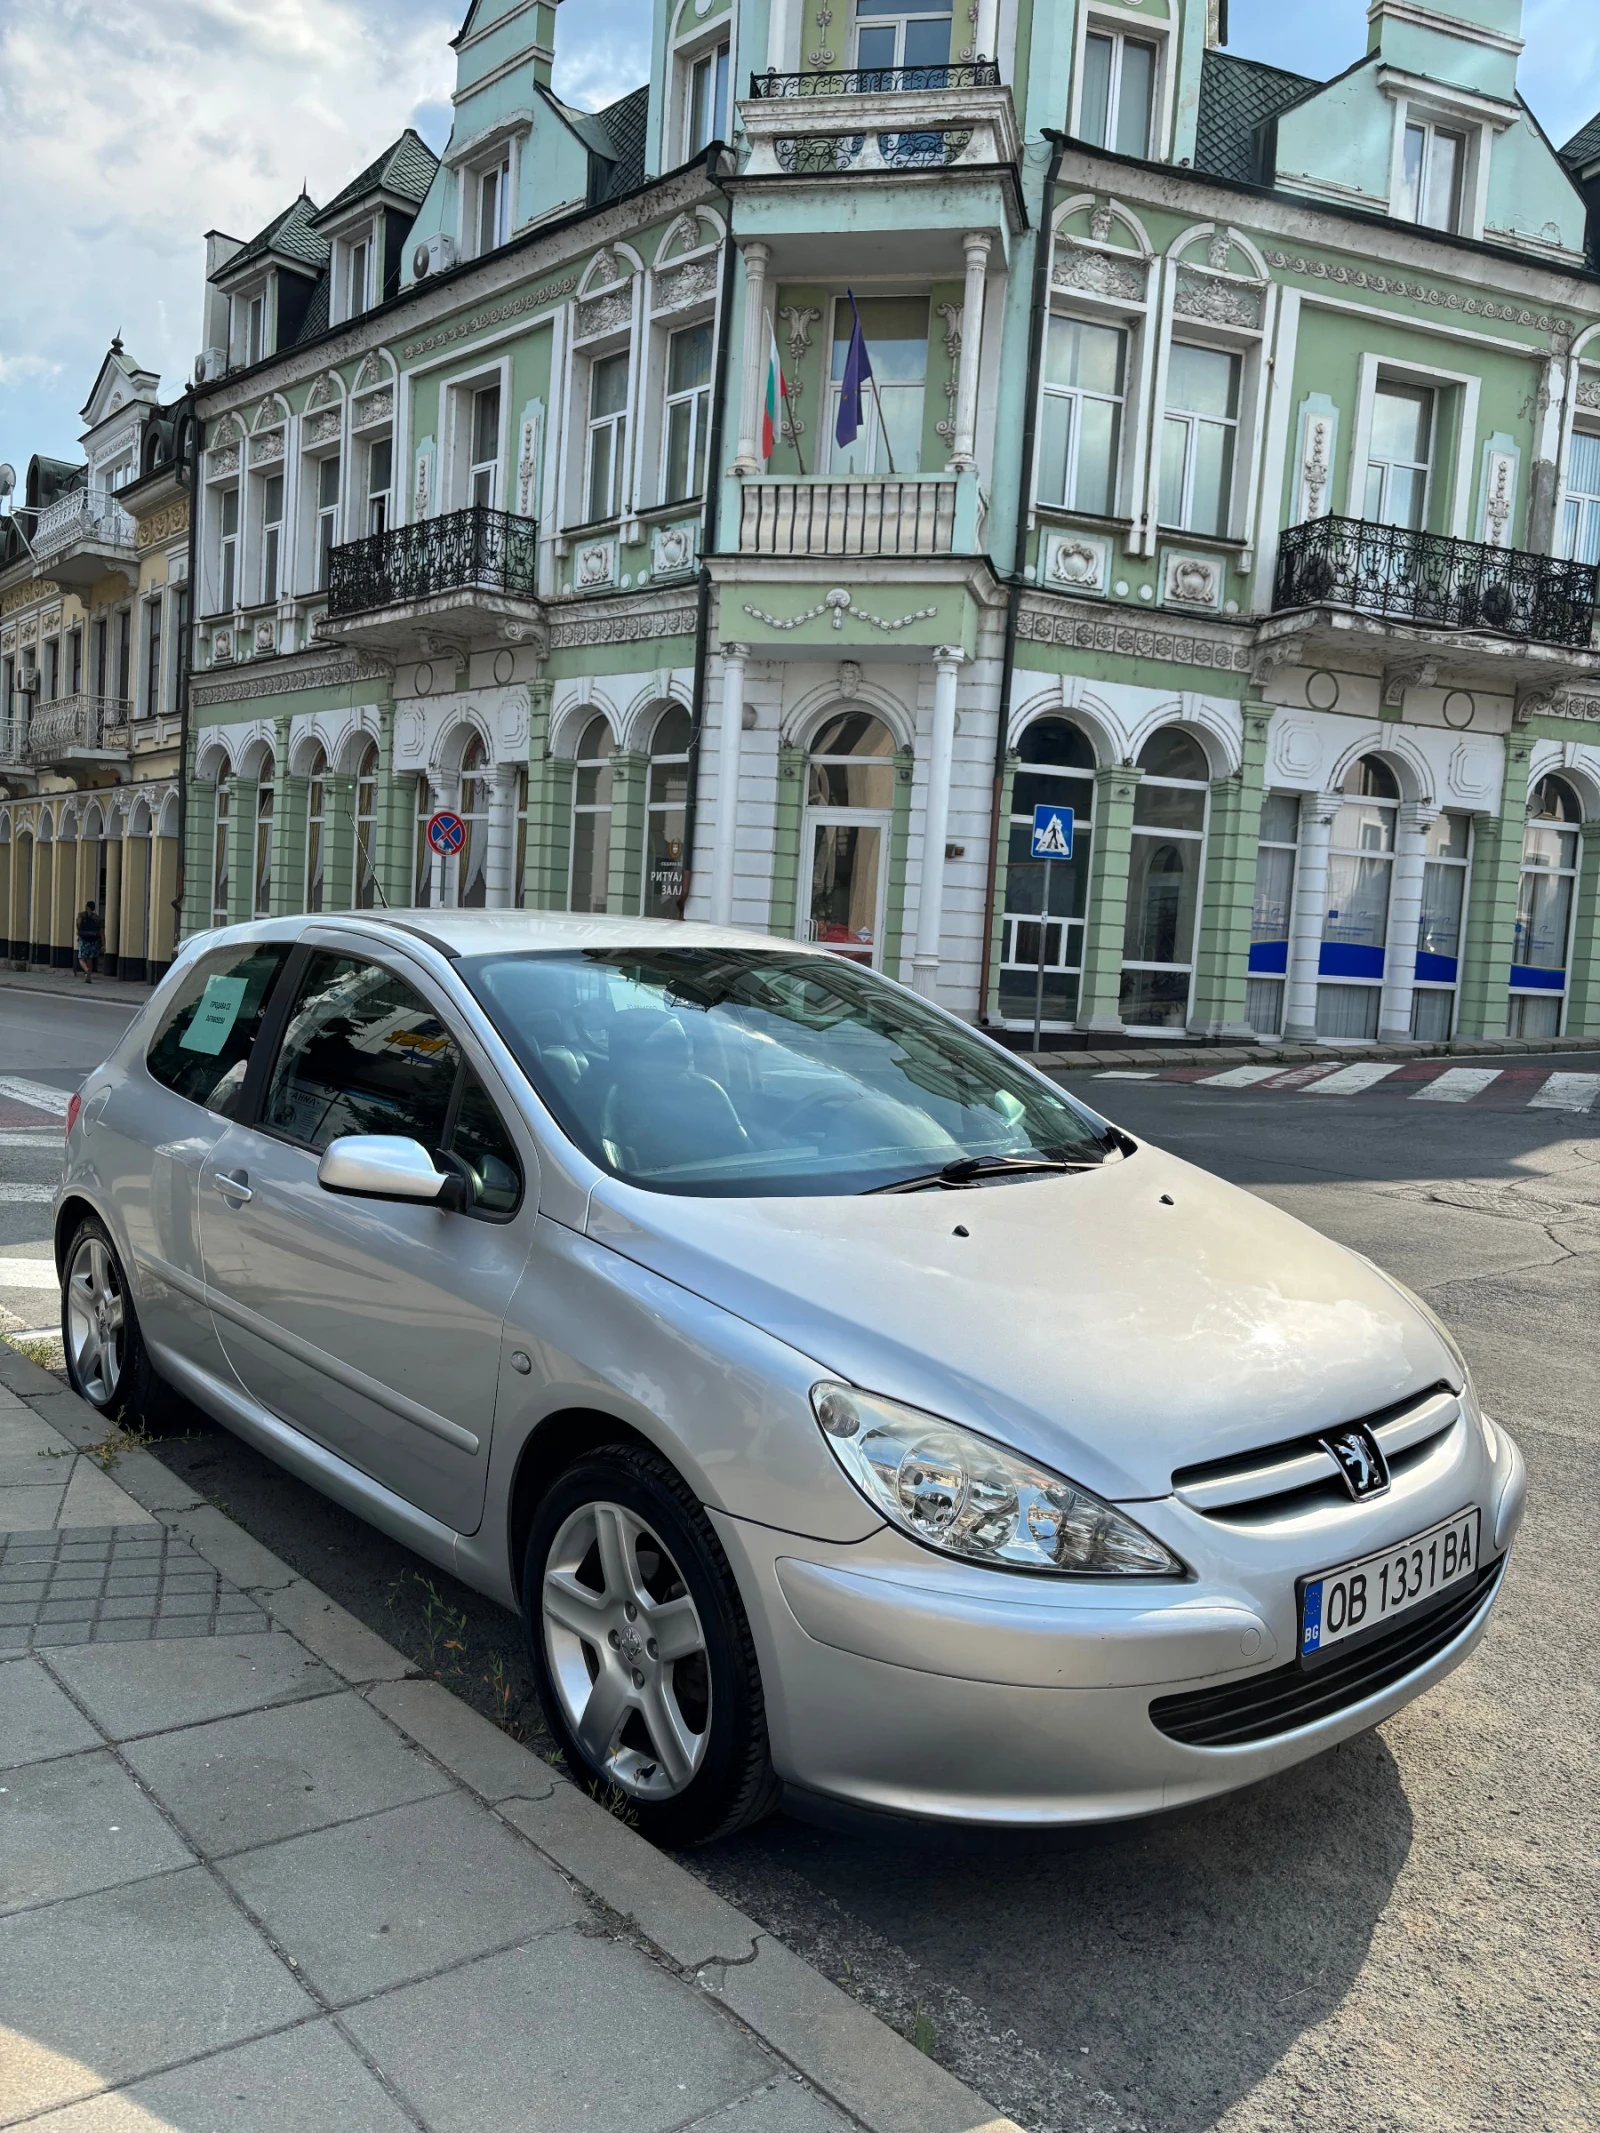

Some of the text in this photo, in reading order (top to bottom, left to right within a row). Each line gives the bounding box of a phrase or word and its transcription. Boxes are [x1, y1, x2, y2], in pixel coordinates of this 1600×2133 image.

[1327, 1573, 1367, 1634] OB
[1442, 1523, 1472, 1581] BA
[1304, 1624, 1320, 1643] BG
